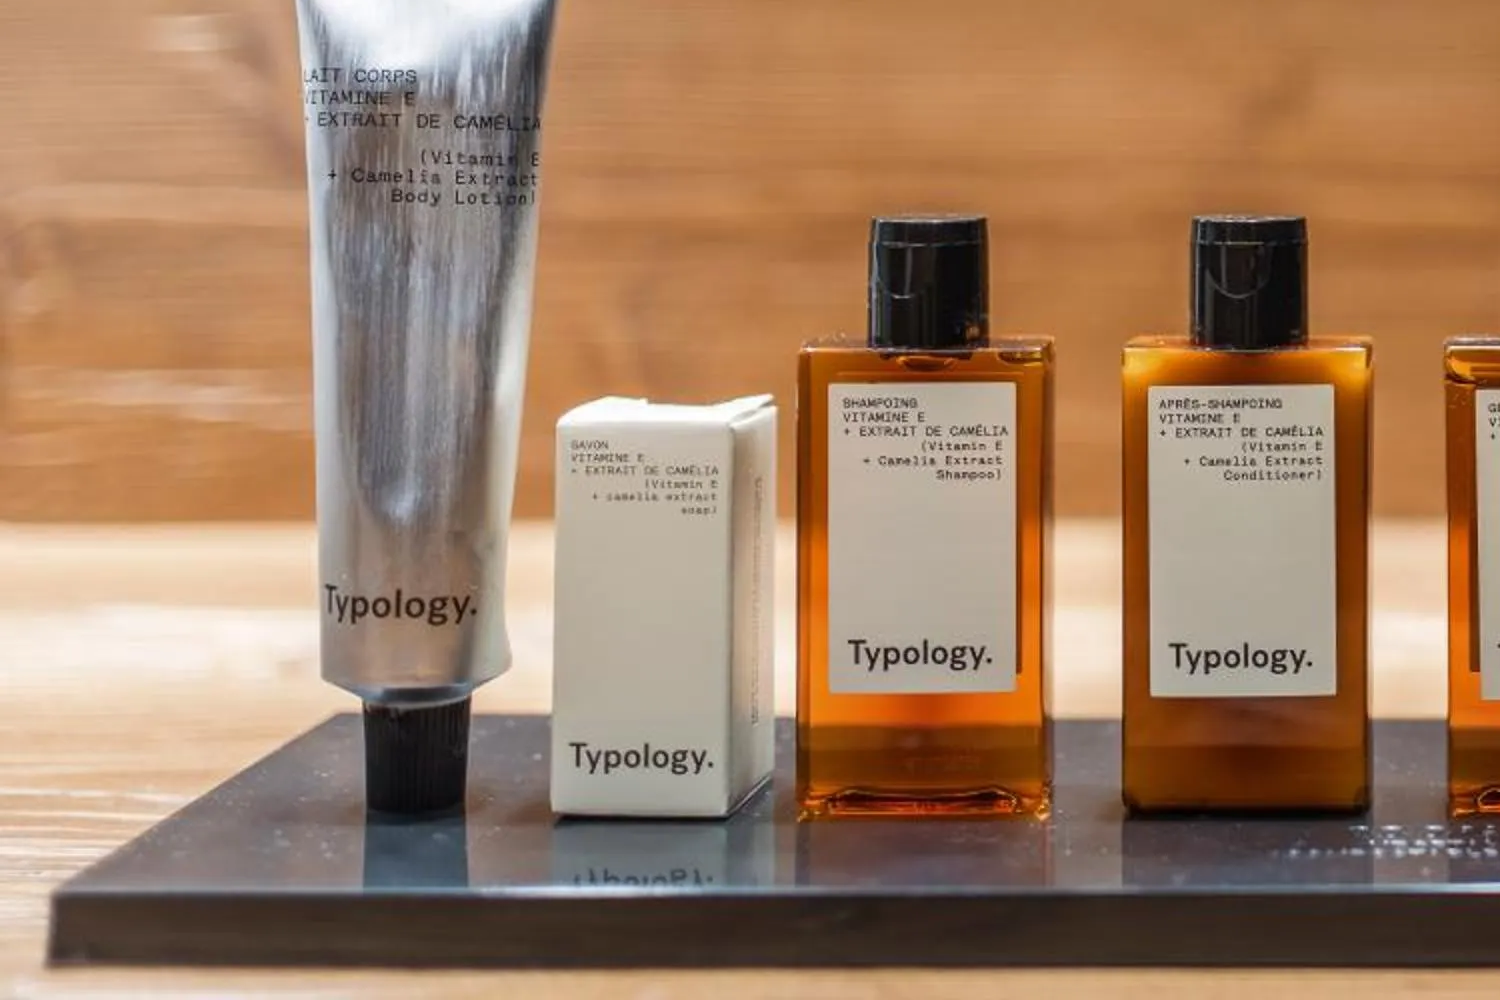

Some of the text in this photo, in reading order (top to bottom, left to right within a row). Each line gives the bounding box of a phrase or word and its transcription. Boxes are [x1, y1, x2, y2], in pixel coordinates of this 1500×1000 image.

[354, 68, 418, 84] CORPS
[403, 91, 415, 106] E
[317, 111, 402, 128] EXTRAIT
[416, 113, 441, 129] DE
[351, 168, 442, 184] Camelia
[455, 169, 538, 187] Extract
[391, 189, 442, 207] Body
[842, 397, 919, 409] SHAMPOING
[1158, 397, 1283, 409] APRÈS-SHAMPOING
[842, 411, 925, 423] VITAMINE E
[1159, 413, 1241, 424] VITAMINE E
[859, 425, 917, 437] EXTRAIT
[925, 425, 942, 437] DE
[949, 423, 1009, 437] CAMÉLIA
[1175, 427, 1232, 438] EXTRAIT
[1241, 427, 1257, 438] DE
[1265, 424, 1325, 437] CAMÉLIA
[570, 440, 610, 450] SAVON
[921, 440, 1003, 452] (Vitamin E
[1240, 441, 1323, 452] (Vitamin E
[571, 453, 645, 463] VITAMINE E
[877, 455, 937, 466] Camelia
[945, 455, 1004, 466] Extract
[1199, 456, 1258, 467] Camelia
[1265, 456, 1323, 467] Extract
[585, 465, 636, 476] EXTRAIT
[643, 465, 660, 476] DE
[935, 469, 1002, 482] Shampoo)
[1223, 469, 1323, 482] Conditioner)
[710, 479, 719, 489] E
[324, 583, 478, 627] Typology.
[847, 638, 993, 673] Typology.
[1167, 641, 1314, 676] Typology.
[568, 741, 715, 776] Typology.
